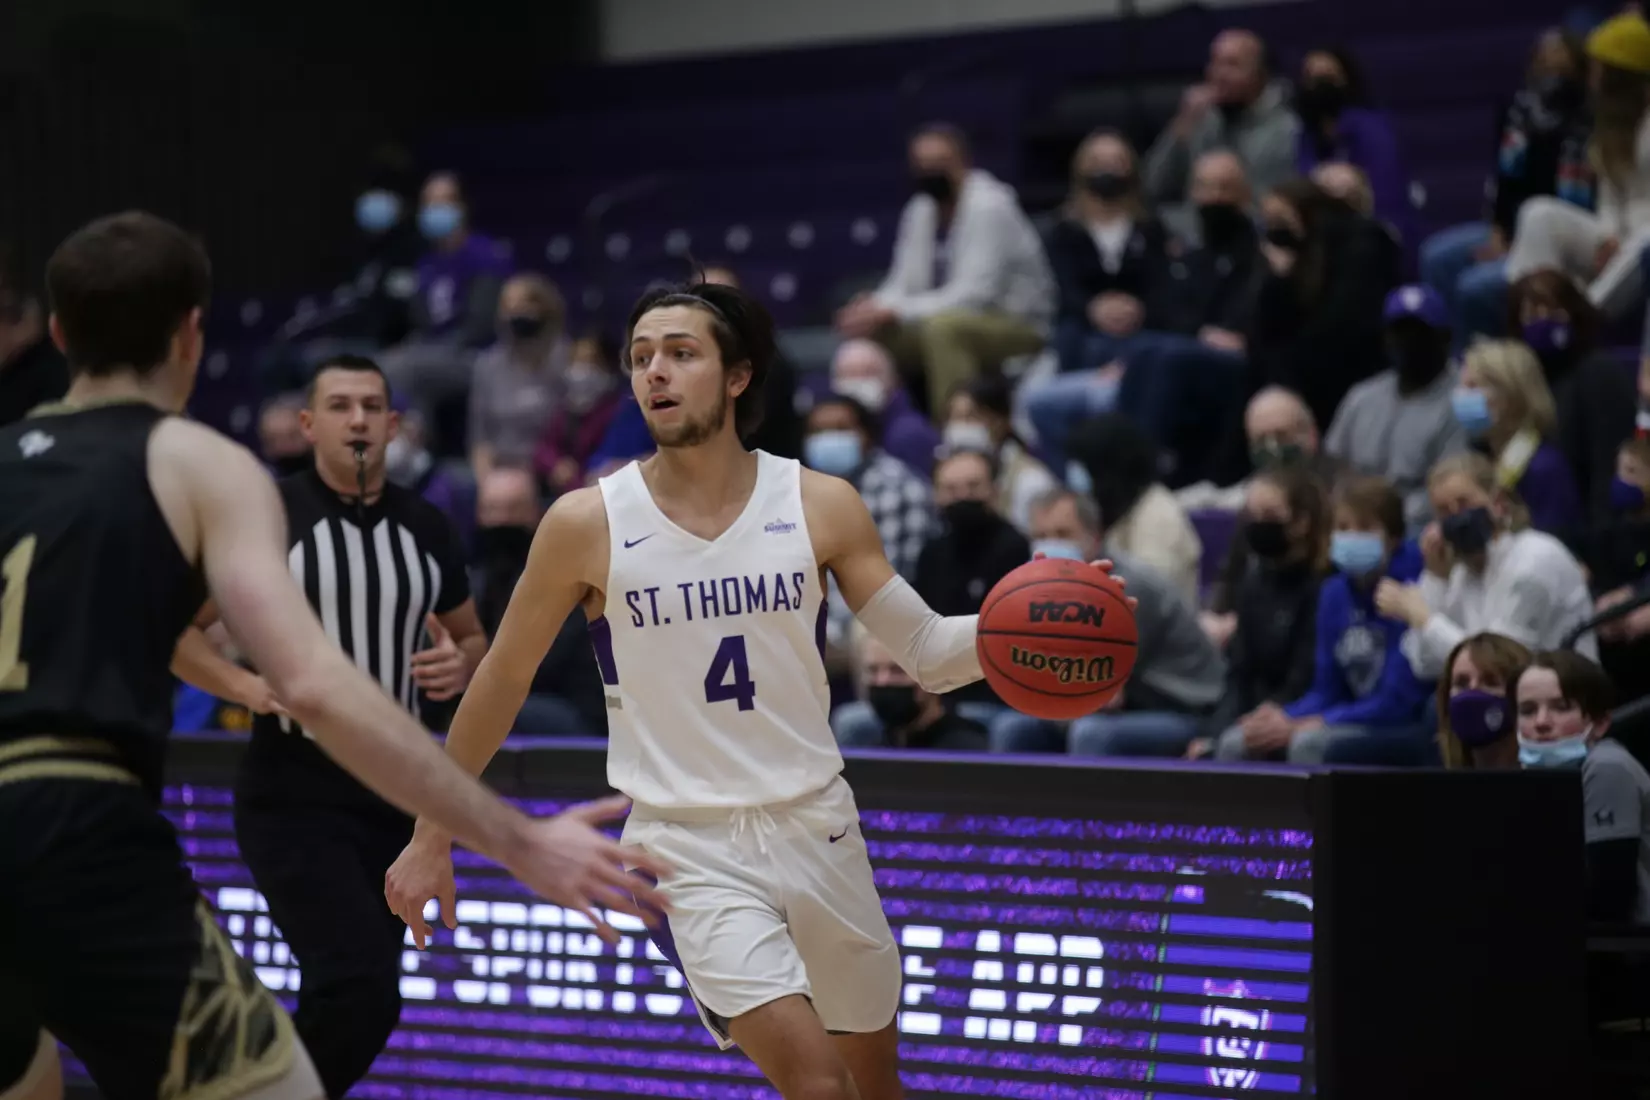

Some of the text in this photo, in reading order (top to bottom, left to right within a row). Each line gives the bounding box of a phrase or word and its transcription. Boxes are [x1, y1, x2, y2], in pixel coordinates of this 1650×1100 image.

[625, 572, 805, 628] ST. THOMAS
[1029, 601, 1105, 628] NCAA
[704, 634, 756, 712] 4
[1010, 646, 1115, 684] Wilson
